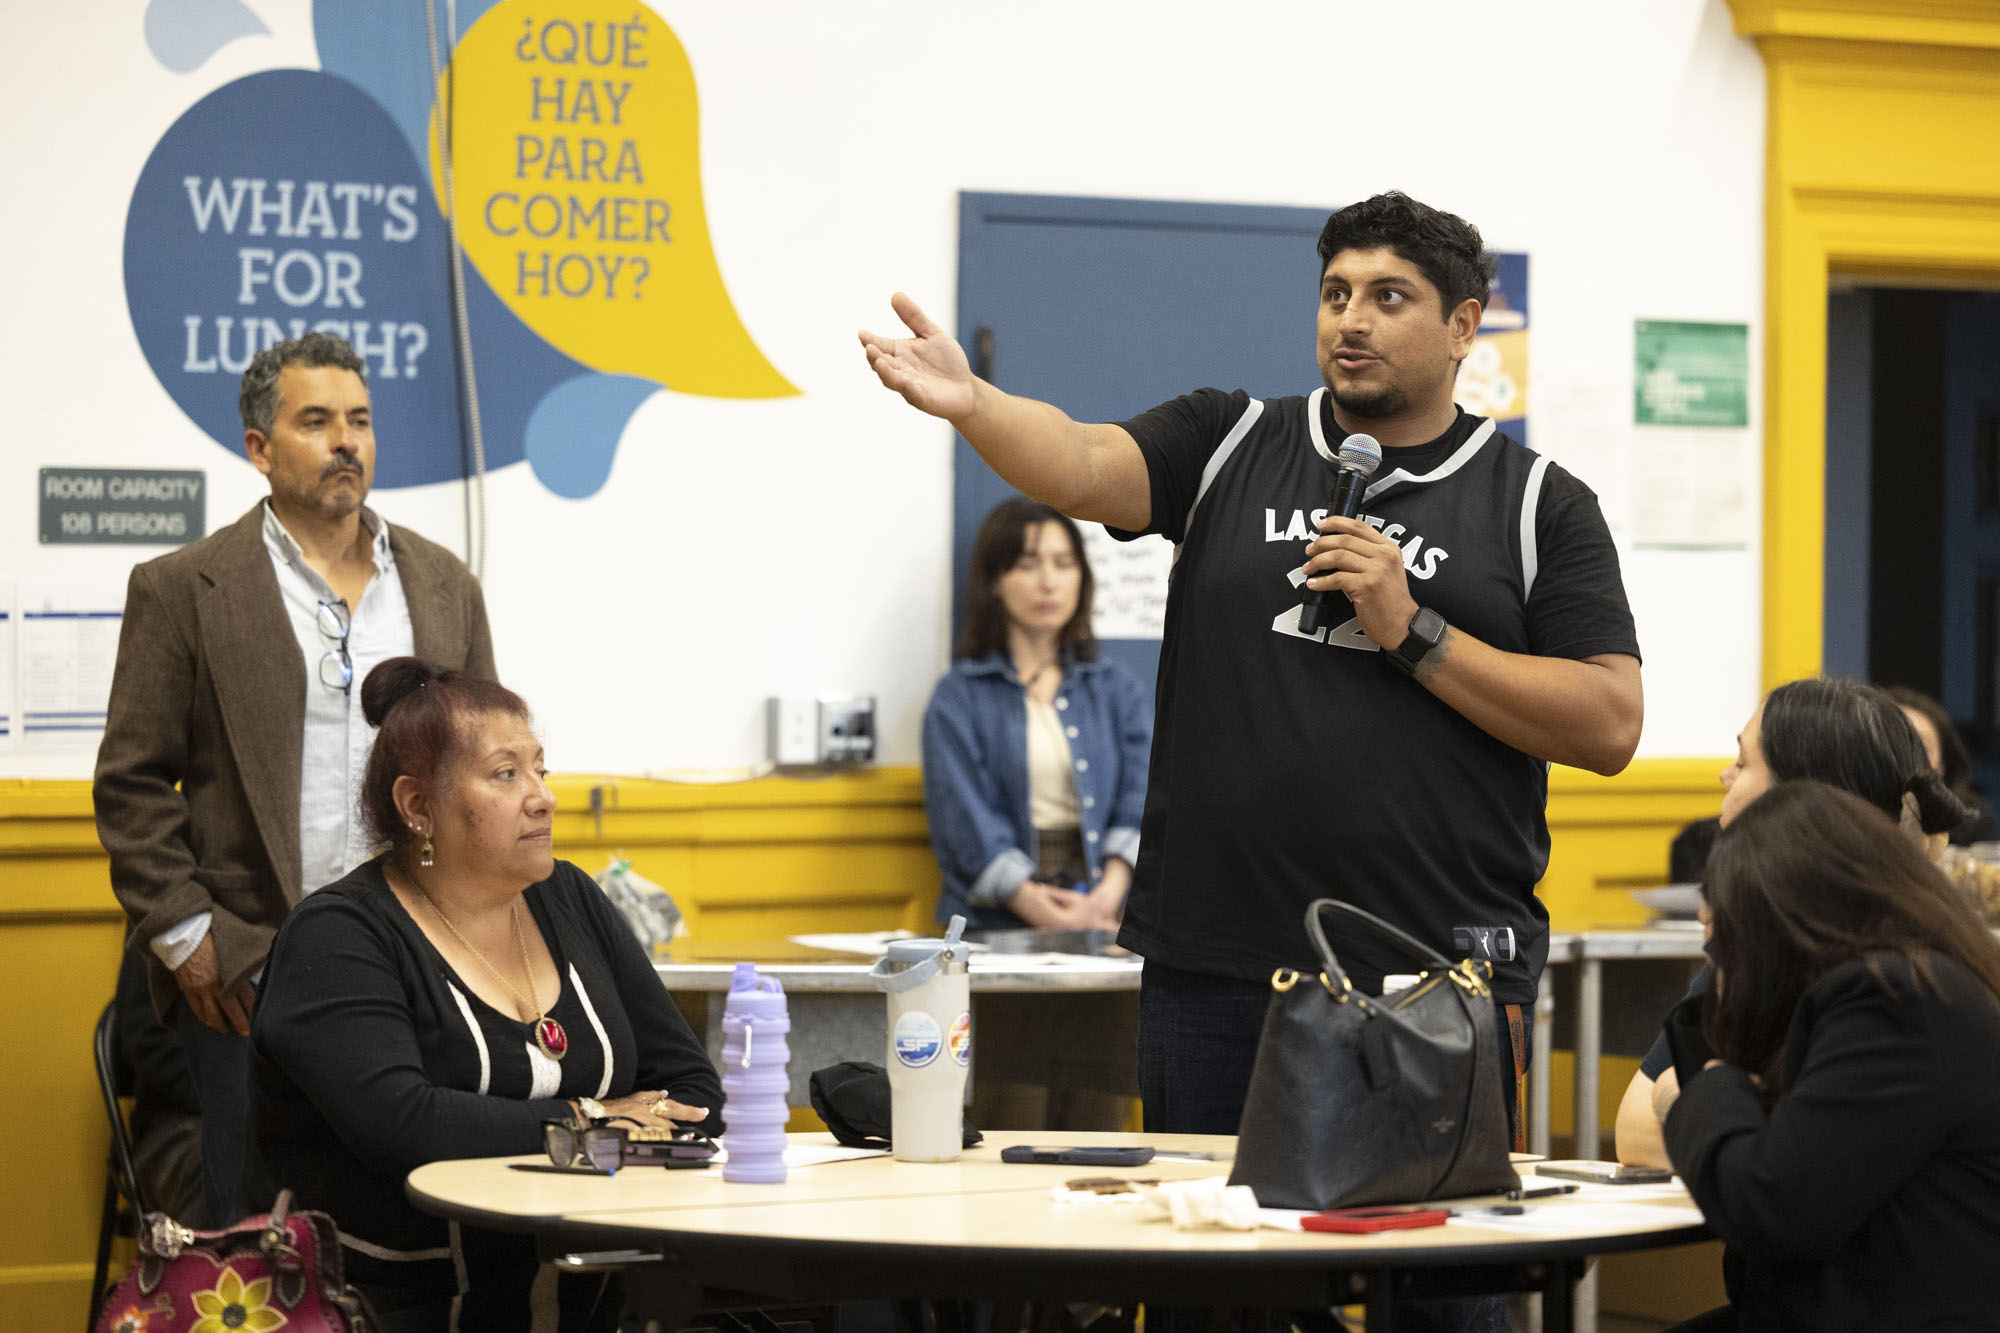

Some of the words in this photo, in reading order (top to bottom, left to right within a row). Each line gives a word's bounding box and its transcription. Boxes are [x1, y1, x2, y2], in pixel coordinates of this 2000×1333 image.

[516, 13, 648, 69] ¿QUÉ
[529, 77, 632, 126] HAY
[515, 134, 644, 185] PARA
[183, 176, 419, 242] WHAT'S
[483, 192, 672, 244] COMER
[238, 248, 365, 309] FOR
[515, 251, 651, 300] HOY?
[184, 316, 428, 379] LUH?
[46, 476, 103, 500] ROOM
[108, 478, 200, 500] CAPACITY
[60, 512, 93, 535] 108
[97, 512, 187, 535] PERSONS
[1356, 513, 1449, 580] GAS
